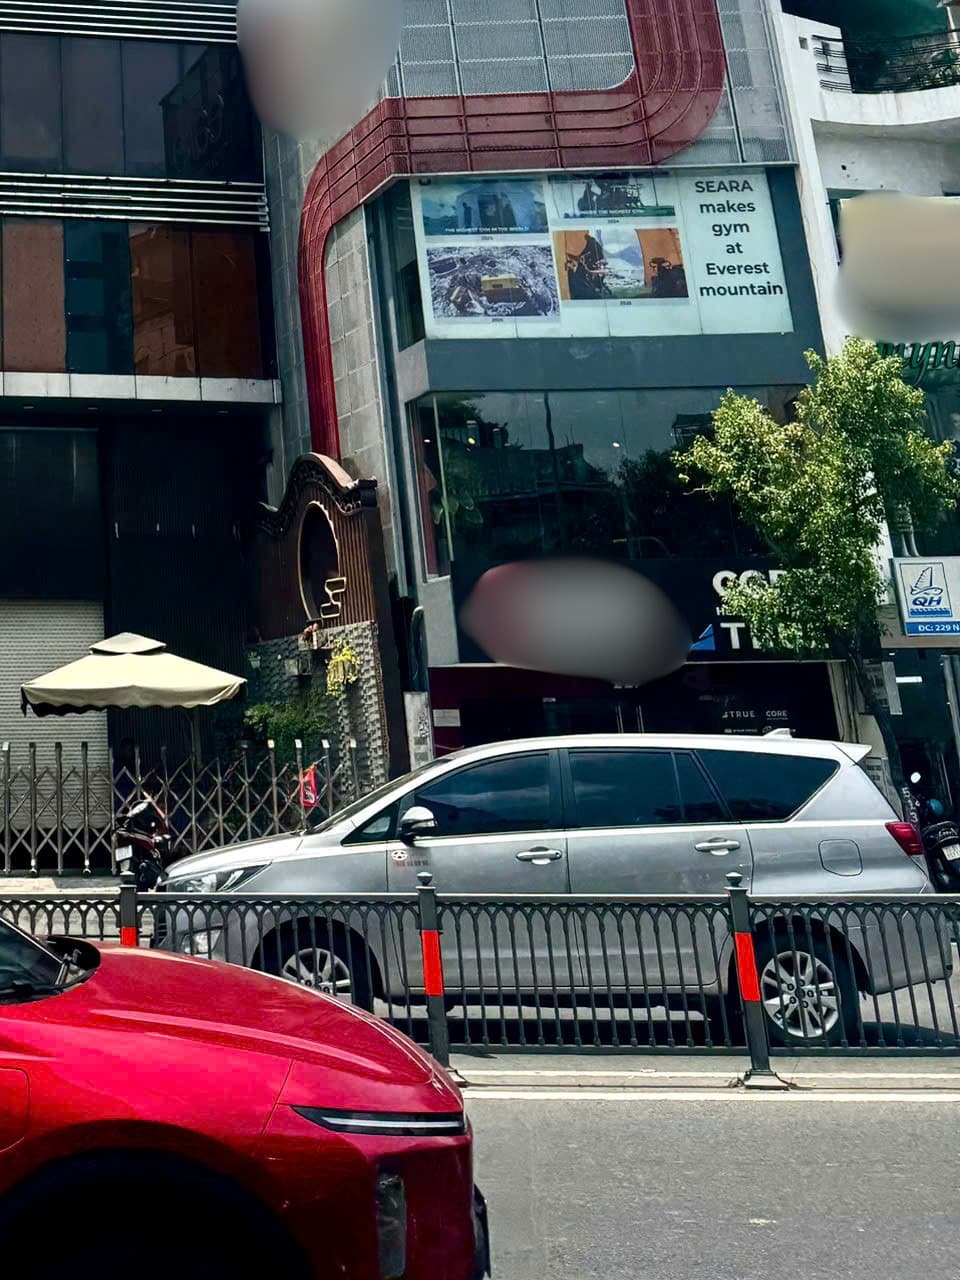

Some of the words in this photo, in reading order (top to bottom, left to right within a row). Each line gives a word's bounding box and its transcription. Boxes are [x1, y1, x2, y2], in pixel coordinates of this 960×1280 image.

[695, 180, 753, 193] SEARA
[699, 199, 756, 214] makes
[712, 223, 750, 237] gym
[726, 241, 743, 254] at
[706, 261, 770, 276] Everest
[699, 281, 784, 297] mountain
[912, 596, 942, 607] QH
[728, 710, 757, 718] TRUE
